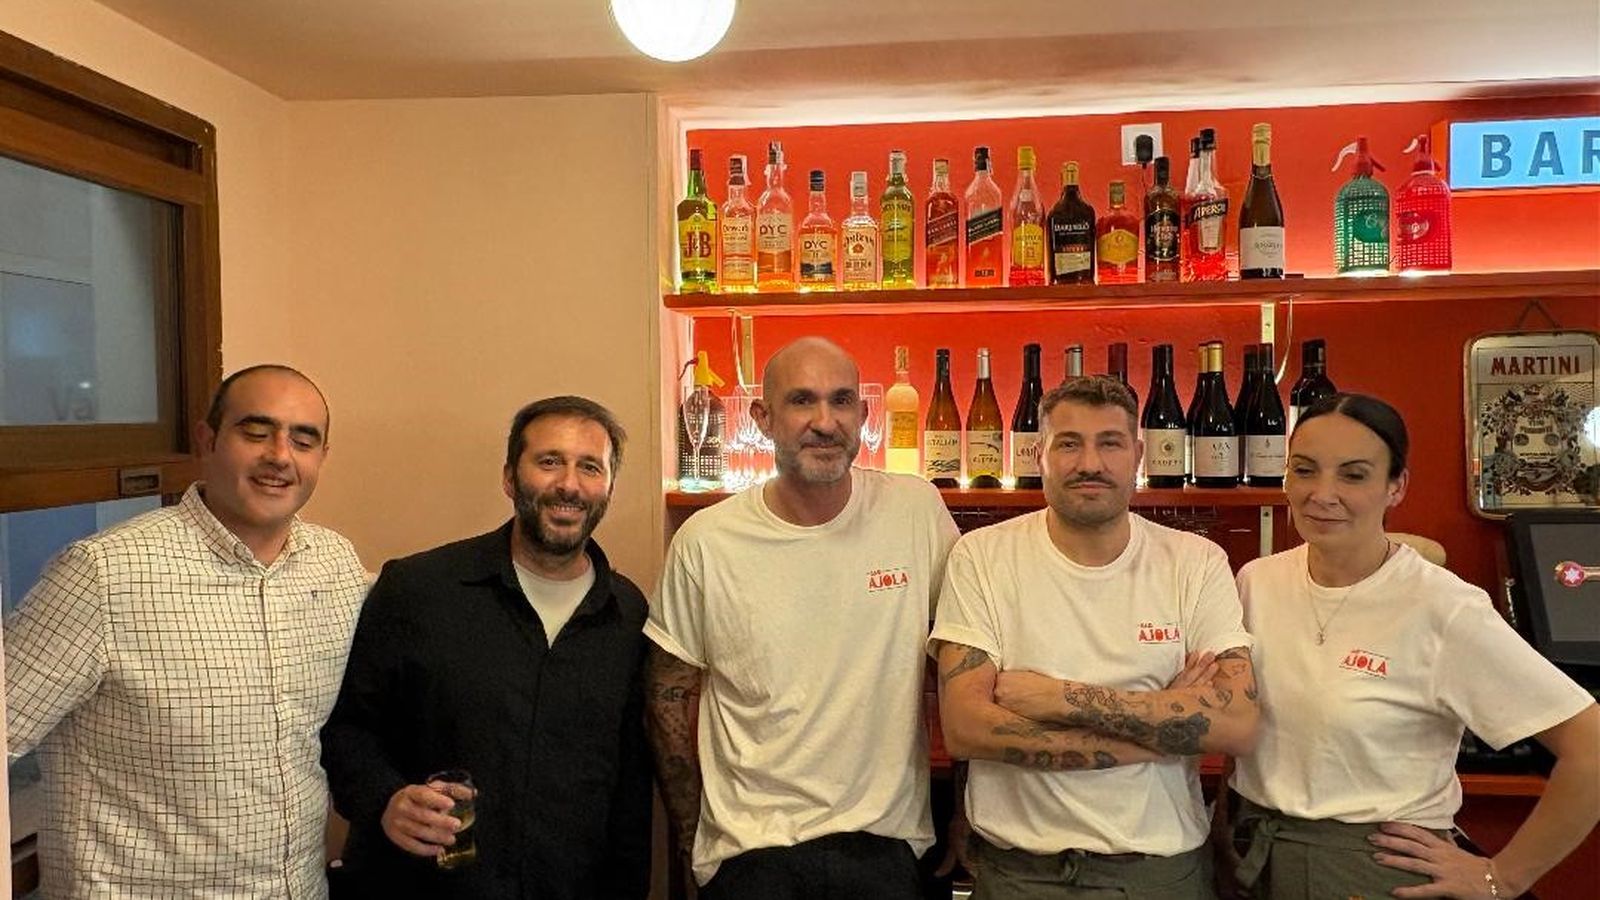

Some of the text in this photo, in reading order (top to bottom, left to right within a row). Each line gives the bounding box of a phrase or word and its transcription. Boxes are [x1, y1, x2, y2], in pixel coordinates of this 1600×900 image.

[1481, 130, 1600, 178] BAR
[759, 224, 788, 236] DYC
[804, 240, 828, 250] DYC
[1491, 355, 1581, 376] MARTINI
[868, 572, 908, 590] AJOLA
[1138, 628, 1180, 642] AJOLA
